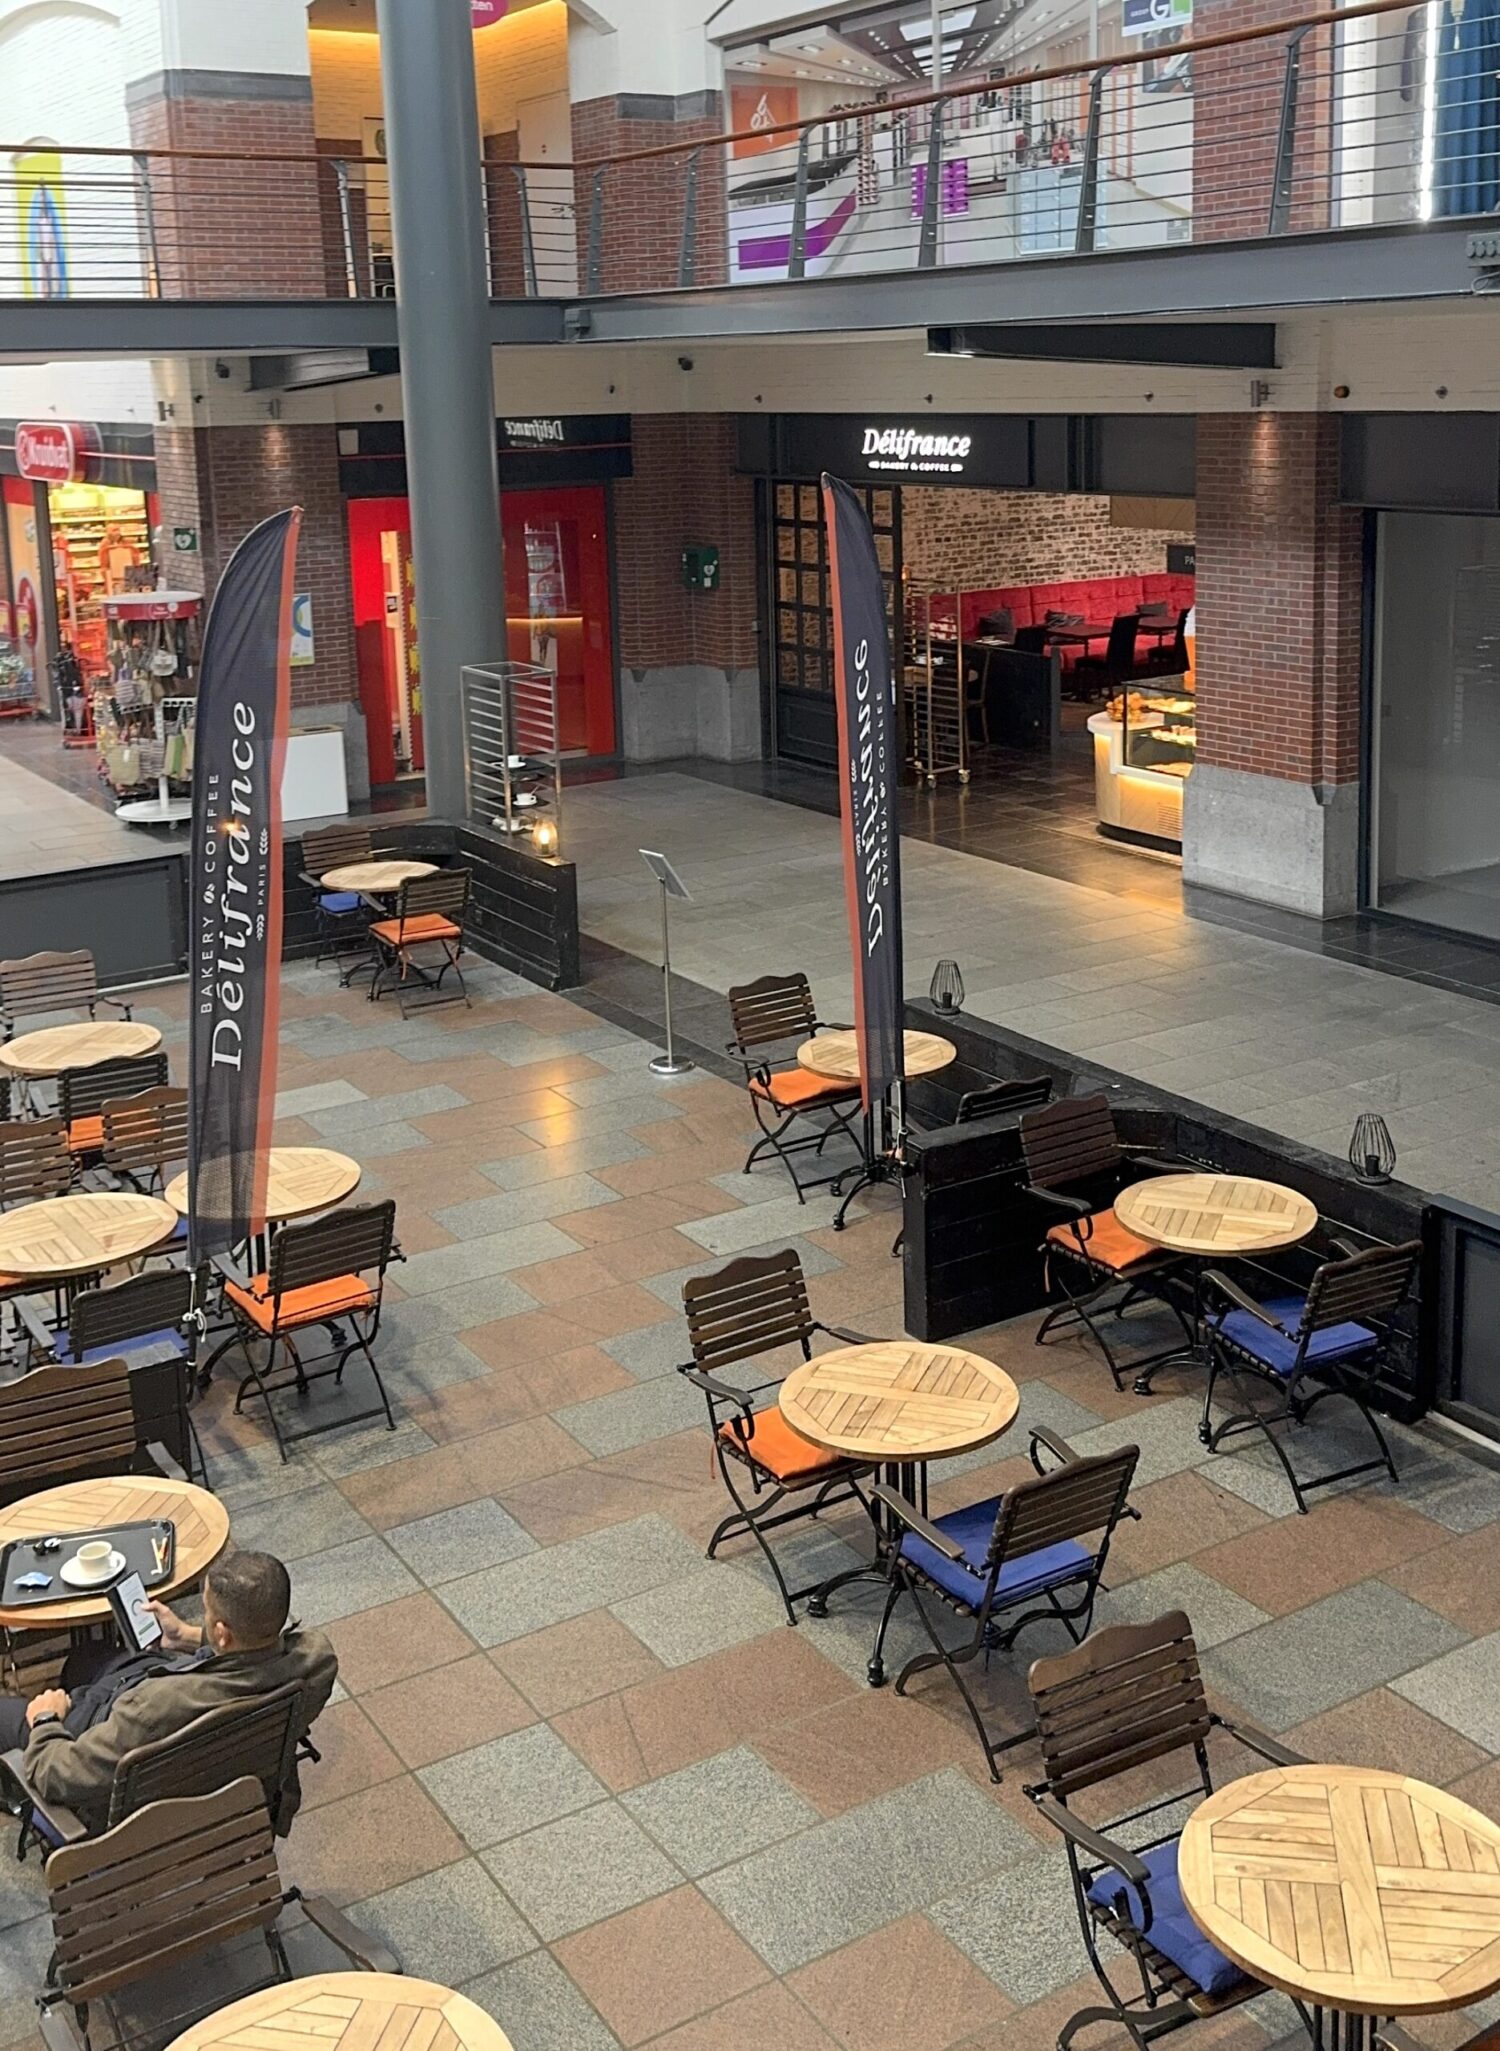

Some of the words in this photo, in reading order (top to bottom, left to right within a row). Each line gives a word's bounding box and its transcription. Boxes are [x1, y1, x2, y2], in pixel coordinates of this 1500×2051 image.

[861, 428, 972, 460] Délifrance
[919, 462, 950, 472] COFFEE
[205, 774, 219, 873] COFFEE
[211, 701, 256, 1071] Délifrance
[257, 863, 266, 906] PARIS
[201, 916, 215, 1013] BAKERY
